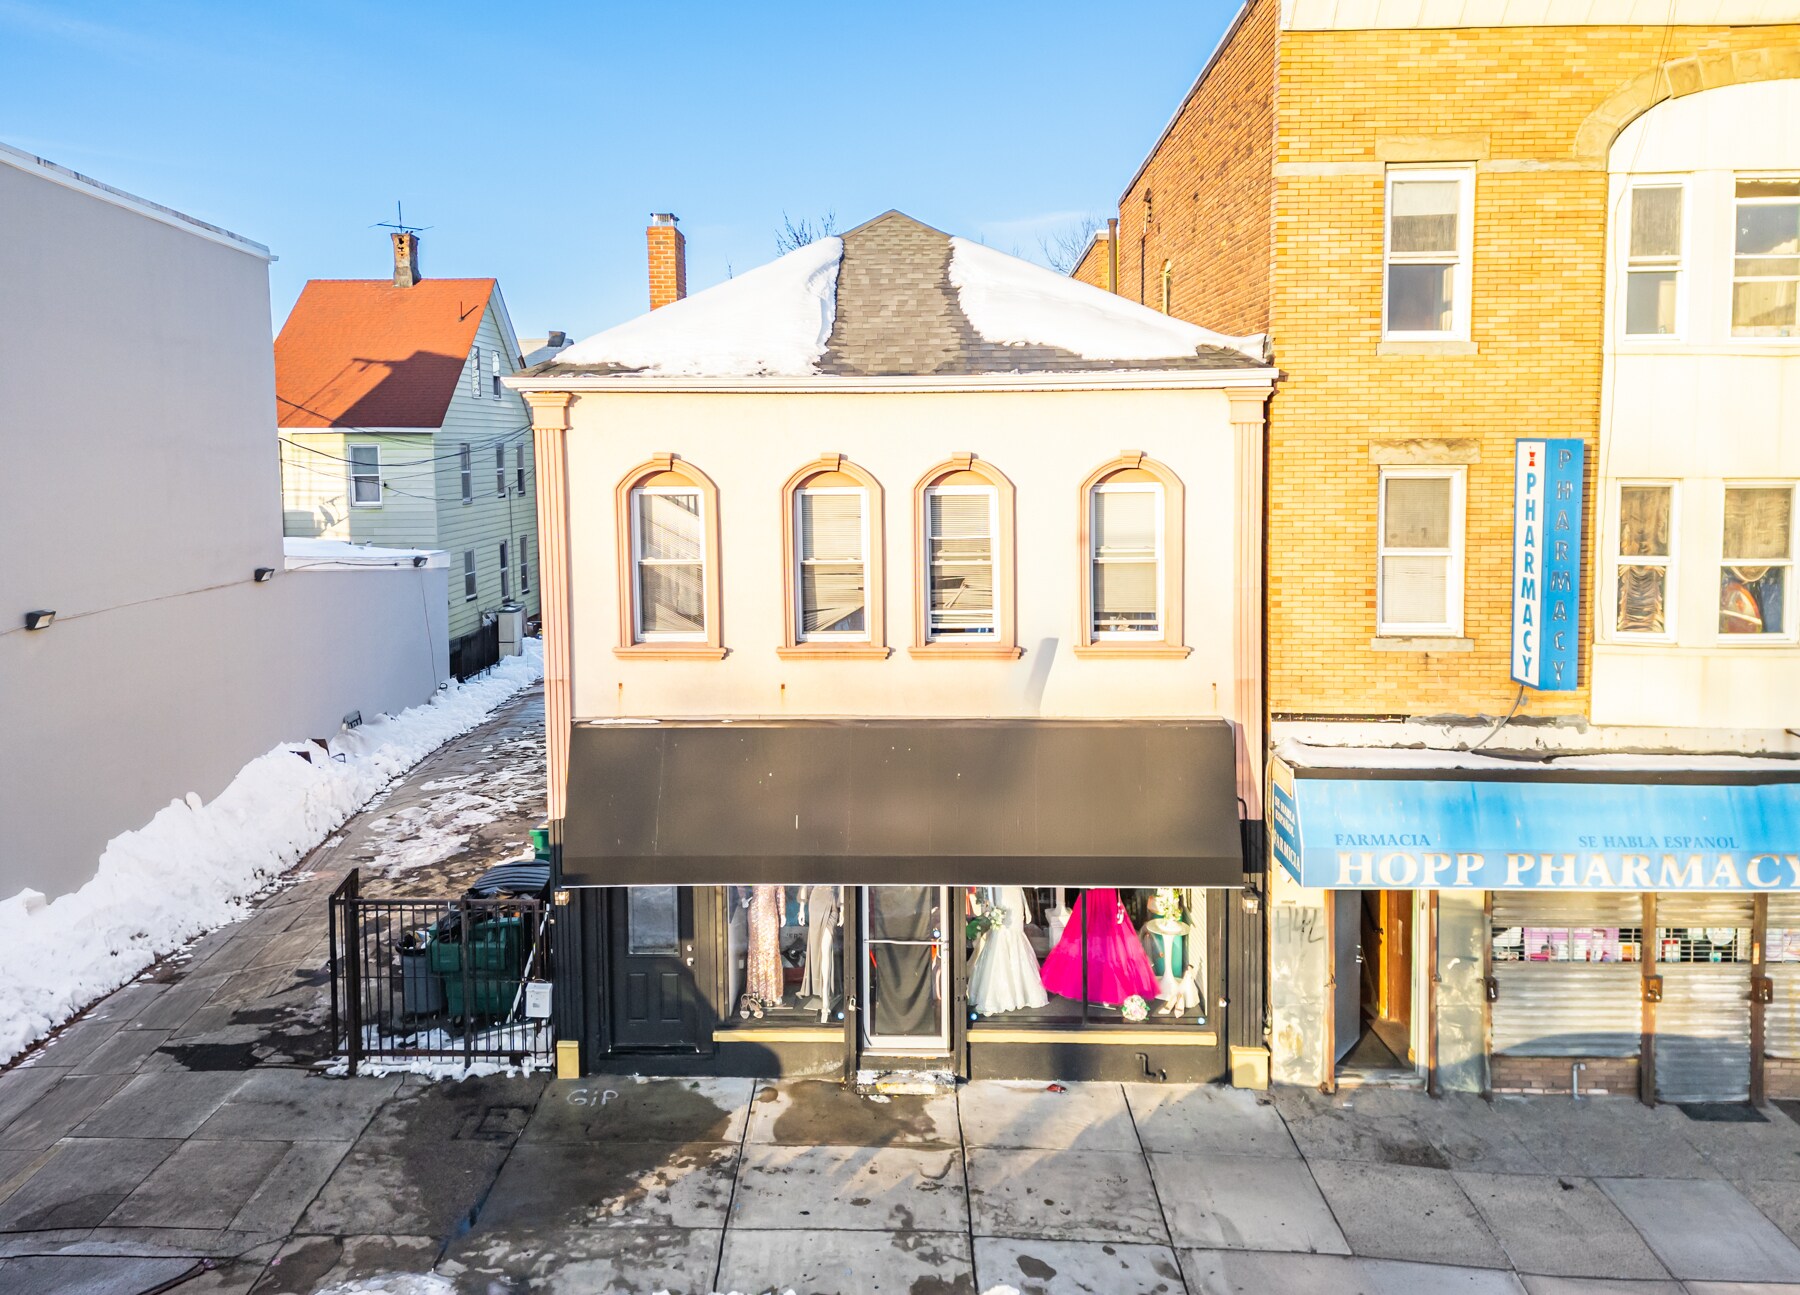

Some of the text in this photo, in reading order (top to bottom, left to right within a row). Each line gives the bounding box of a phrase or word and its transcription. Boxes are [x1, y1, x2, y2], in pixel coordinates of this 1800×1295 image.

[1521, 472, 1537, 678] PHARMACY
[1551, 449, 1573, 683] PHARMACY
[1335, 834, 1431, 846] FARMACIA
[1578, 836, 1740, 849] SE HABLA ESPANOL
[1335, 852, 1485, 886] HOPP
